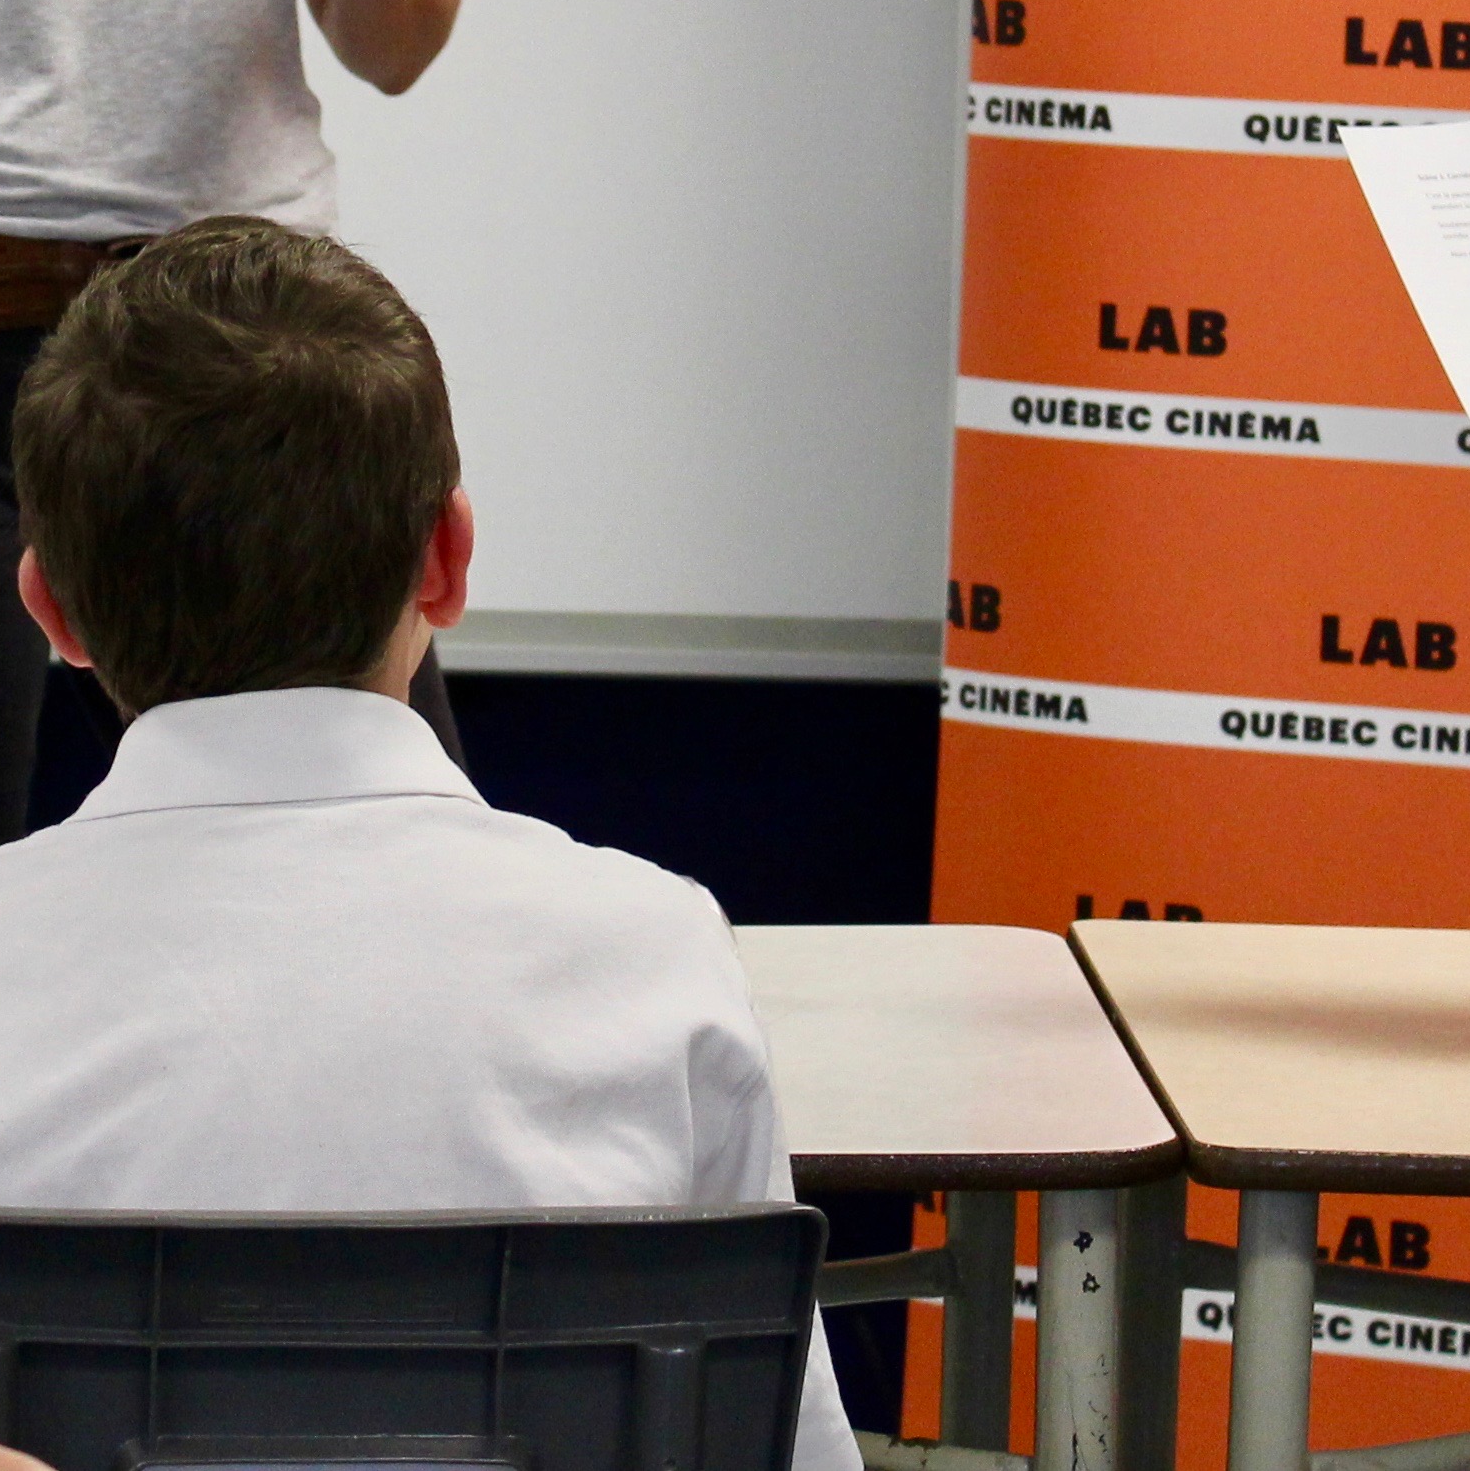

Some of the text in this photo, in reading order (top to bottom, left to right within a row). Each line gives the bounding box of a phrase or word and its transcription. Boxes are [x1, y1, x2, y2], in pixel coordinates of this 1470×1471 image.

[985, 96, 1113, 132] CINÉMA
[1098, 302, 1229, 357] LAB
[1011, 394, 1322, 444] QUÉBEC CINÉMA
[1320, 614, 1458, 673] LAB
[959, 683, 1089, 725] CINÉMA
[1220, 708, 1378, 748] QUÉBEC
[1317, 1215, 1432, 1272] AB
